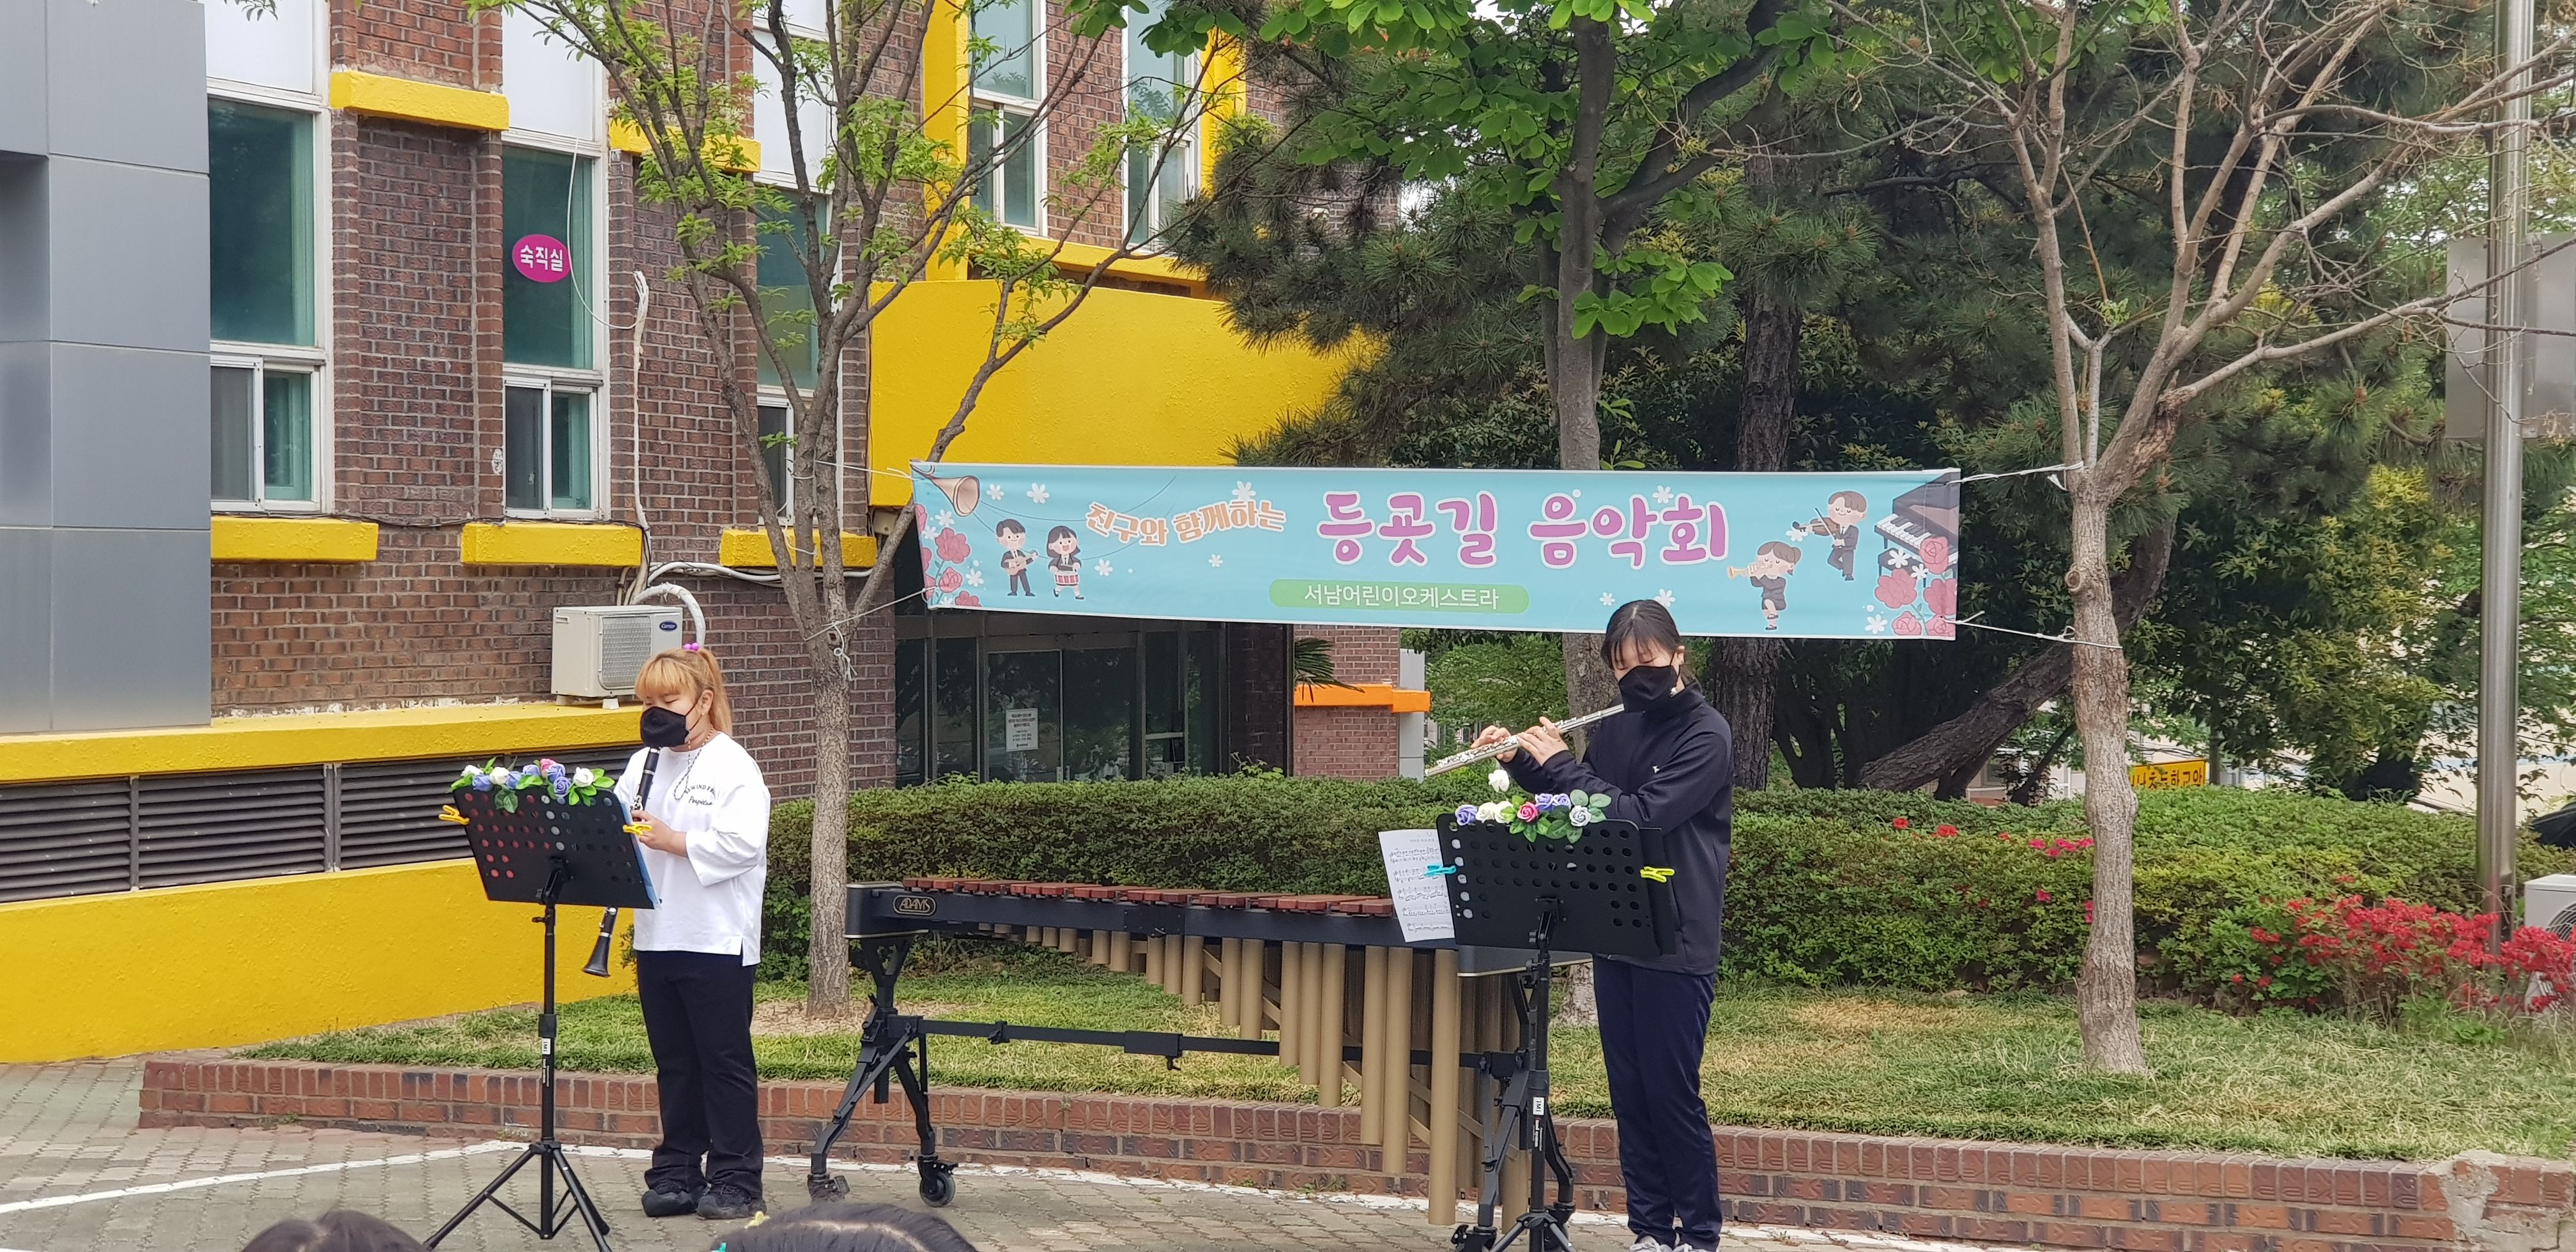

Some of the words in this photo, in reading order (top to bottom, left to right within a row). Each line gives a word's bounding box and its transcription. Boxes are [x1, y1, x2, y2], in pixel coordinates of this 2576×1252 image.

[520, 245, 563, 272] 숙직실
[1086, 502, 1167, 546] 친구와
[1174, 499, 1285, 544] 함께하는
[1318, 491, 1498, 568] 등굣길
[1528, 492, 1729, 569] 음악회
[1304, 584, 1499, 611] 서남어린이오케스트라
[899, 897, 930, 912] ADAMS
